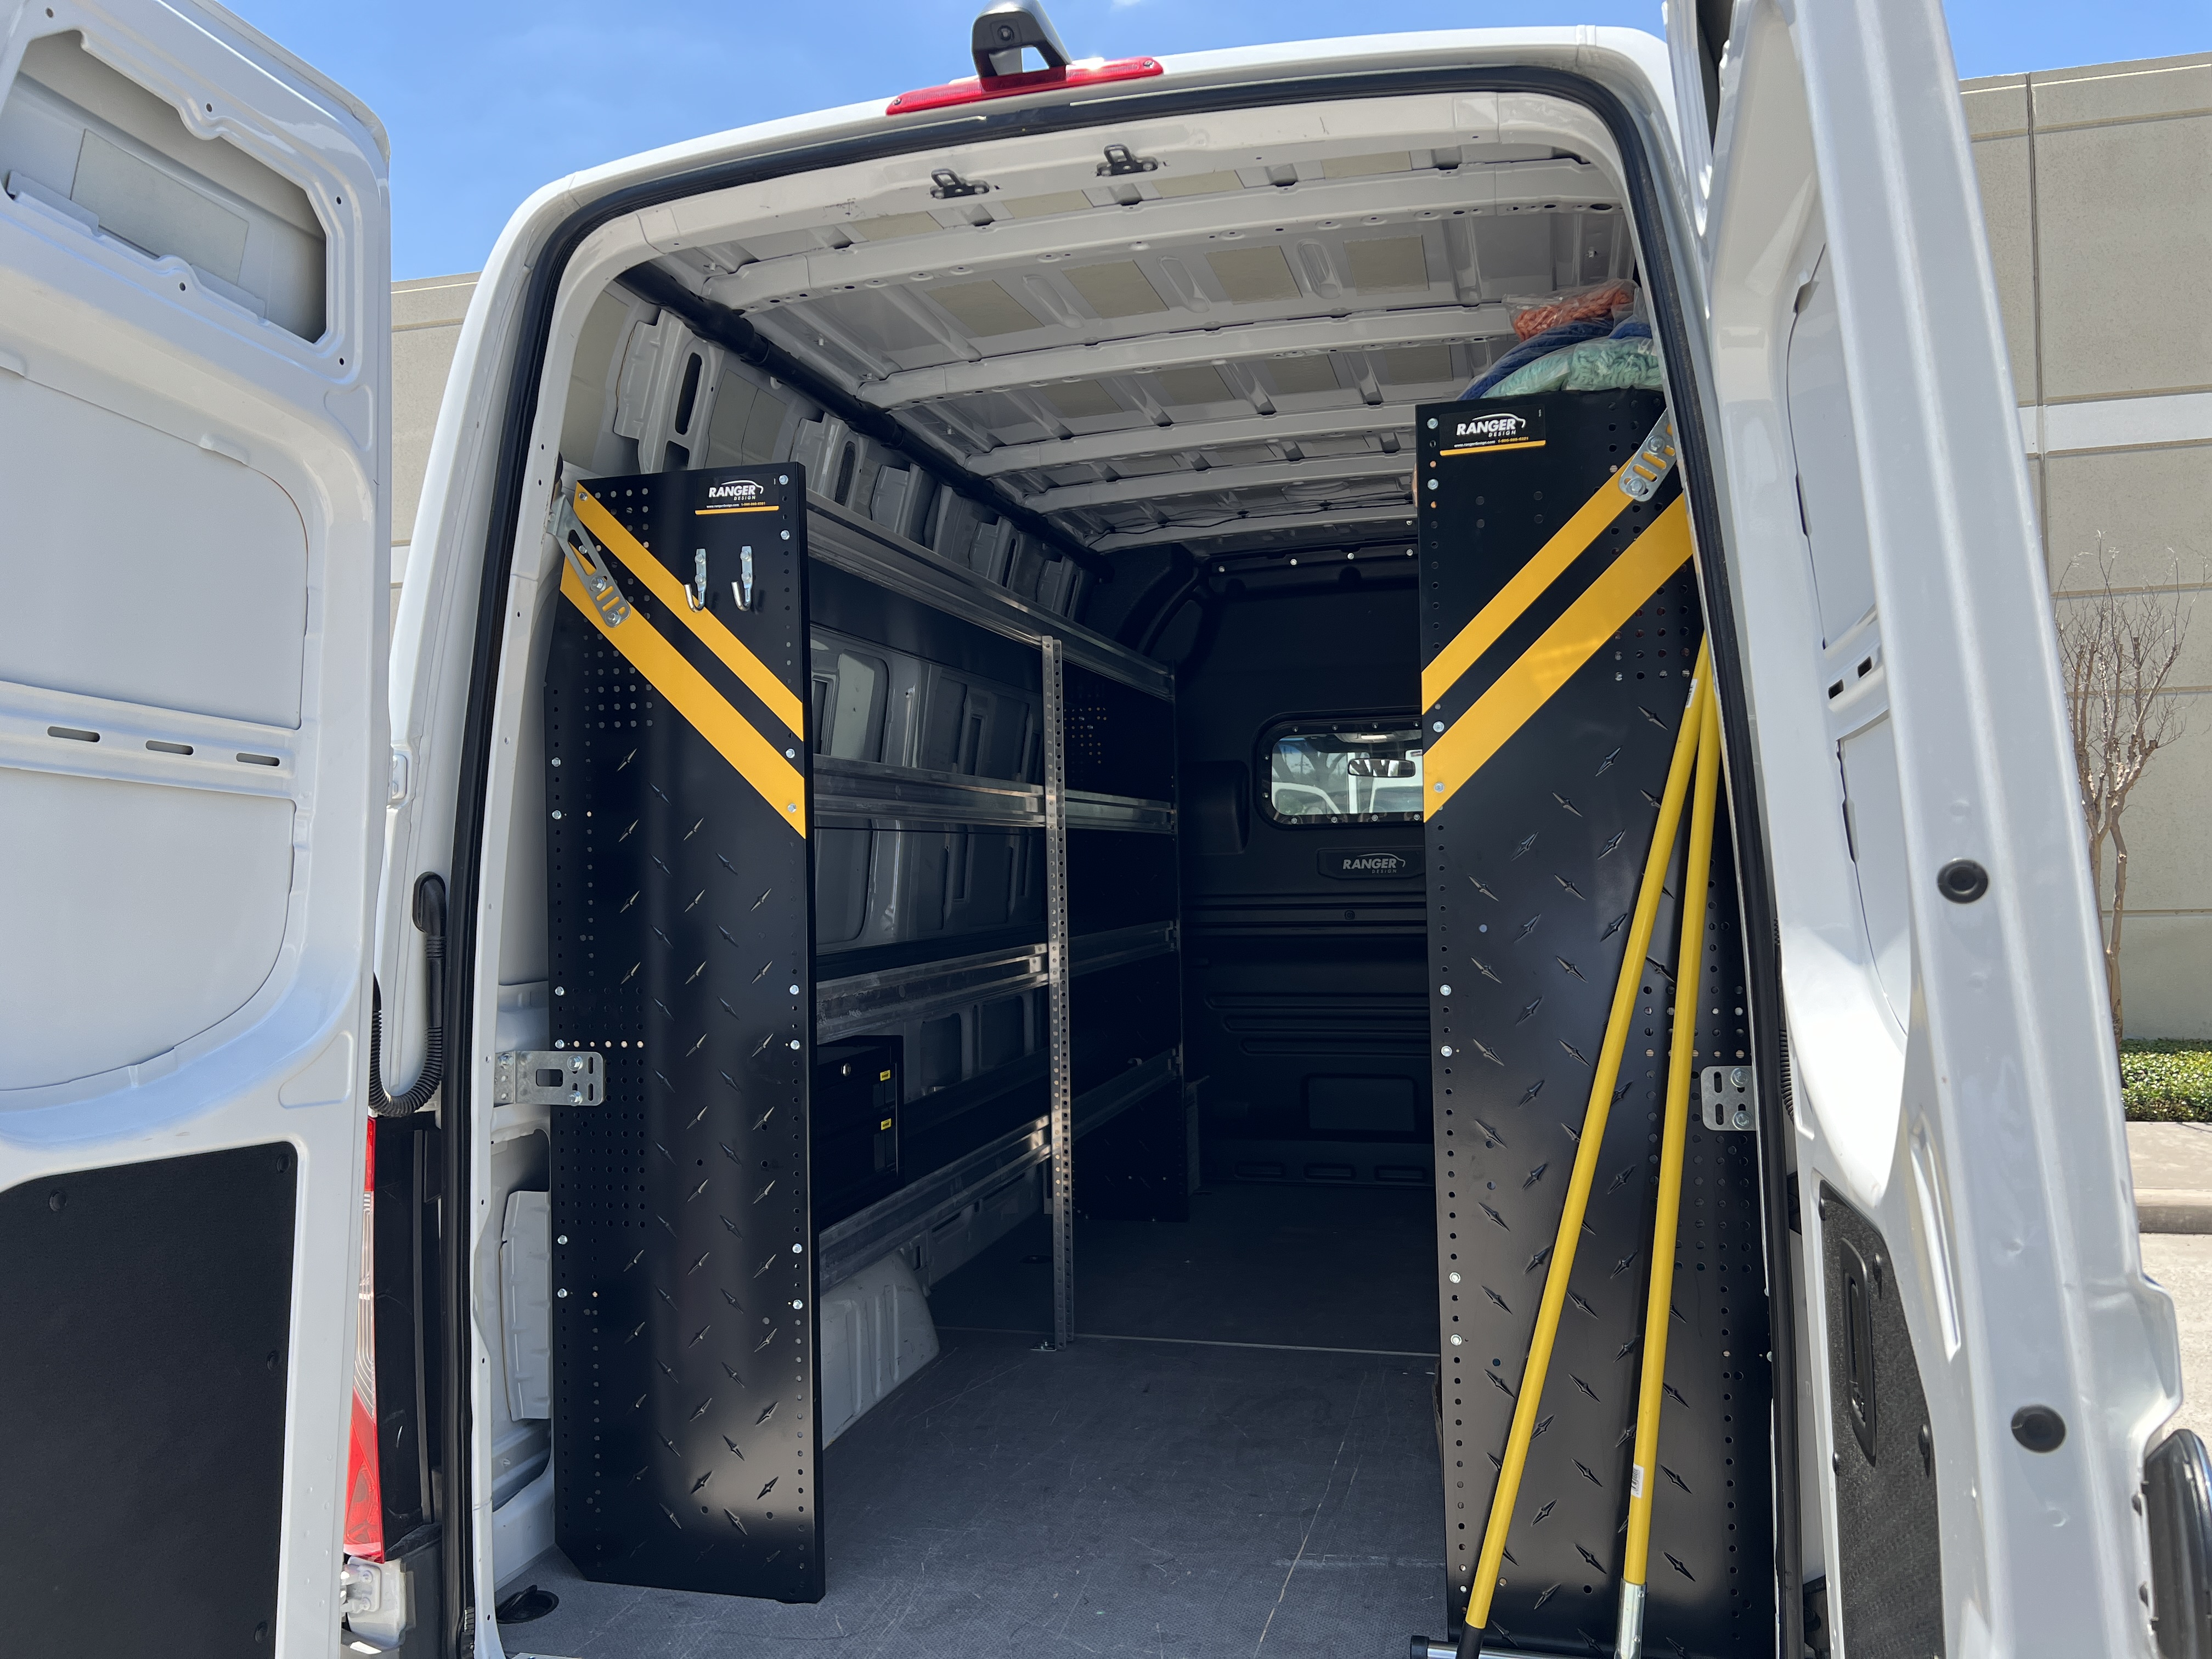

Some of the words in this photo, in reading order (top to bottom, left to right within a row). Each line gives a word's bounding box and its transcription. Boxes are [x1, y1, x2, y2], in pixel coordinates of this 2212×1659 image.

[1456, 418, 1516, 436] RANGER
[708, 484, 756, 498] RANGER
[1342, 858, 1397, 870] RANGER
